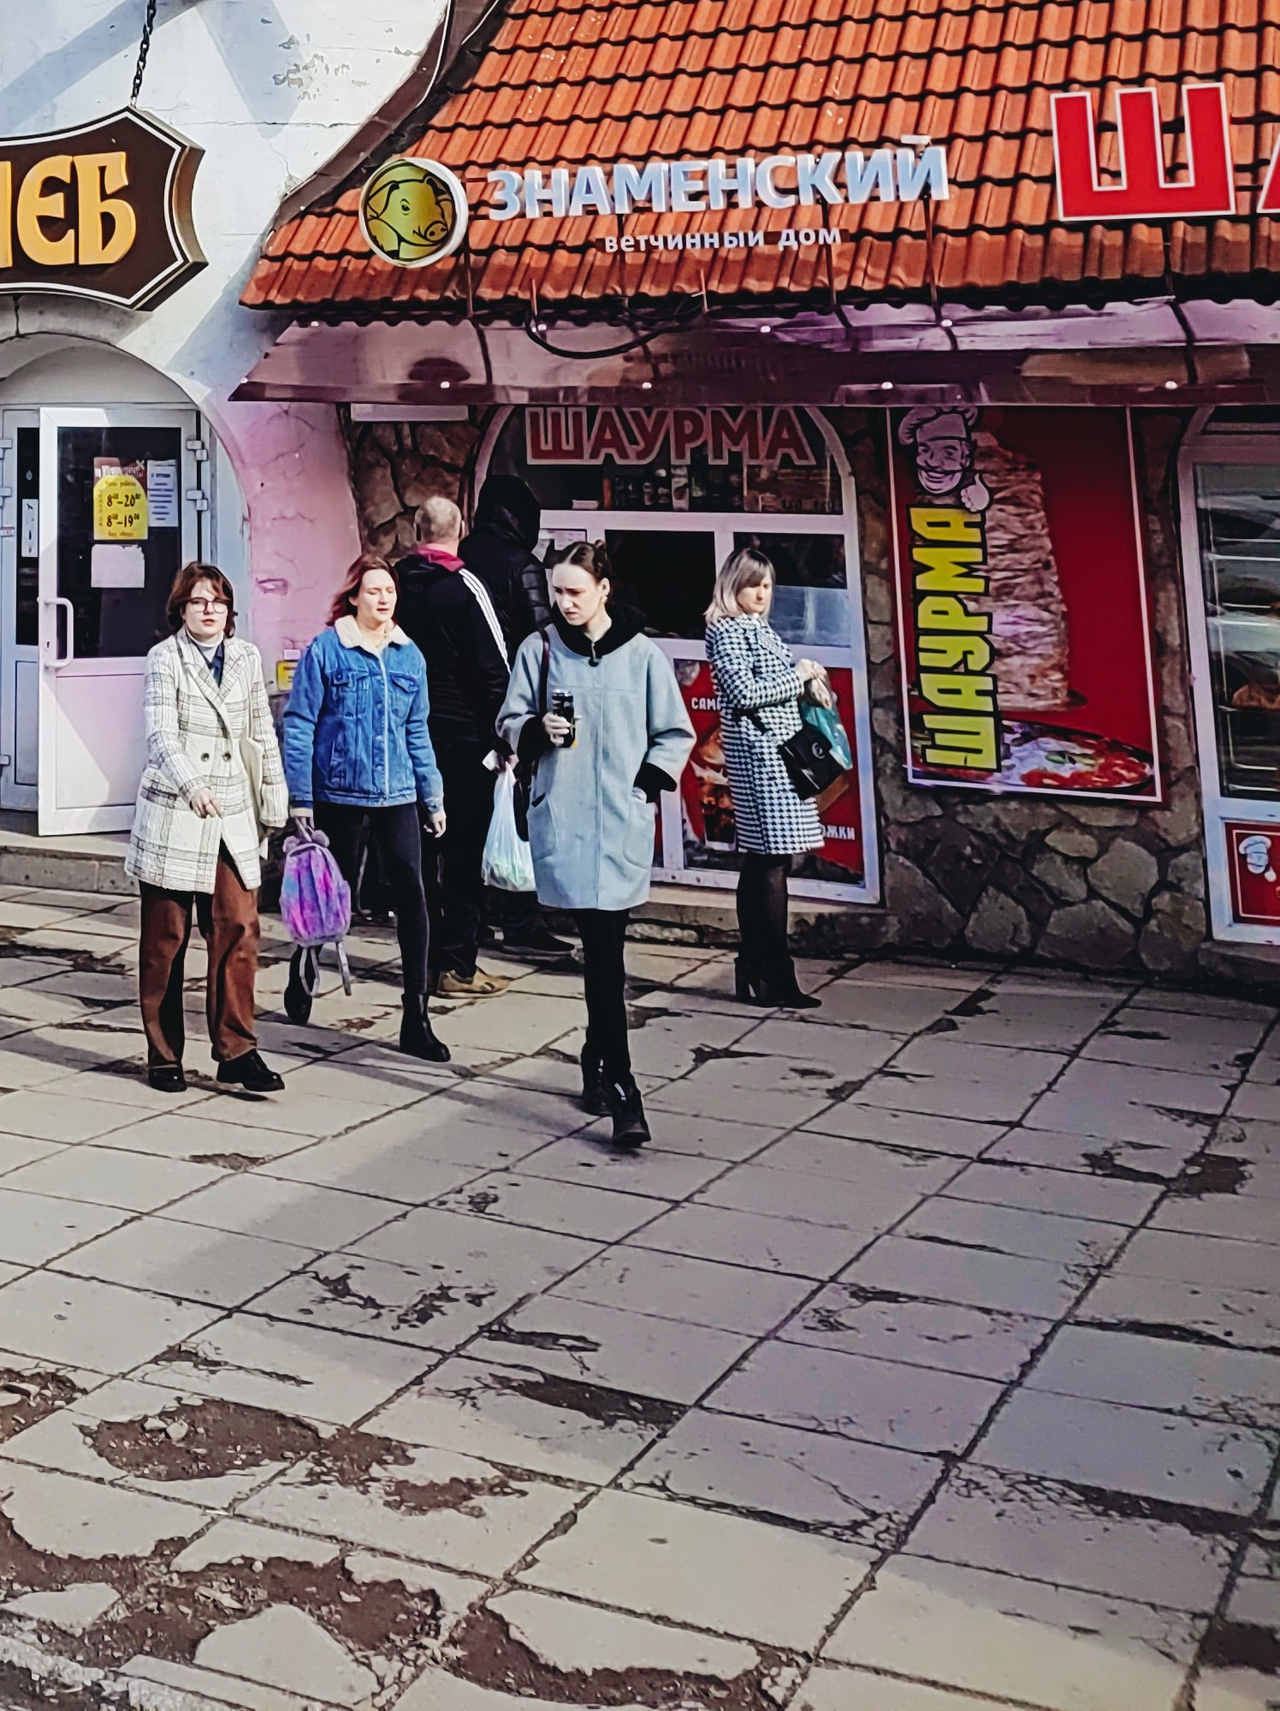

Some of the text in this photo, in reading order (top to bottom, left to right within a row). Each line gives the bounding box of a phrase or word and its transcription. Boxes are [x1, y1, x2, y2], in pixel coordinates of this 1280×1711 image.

[487, 135, 950, 221] ЗНАМЕНСКИЙ
[1050, 82, 1280, 221] Ш
[778, 228, 841, 251] дом
[525, 406, 816, 465] ШАУРМА
[907, 505, 1000, 771] ШАУРМА
